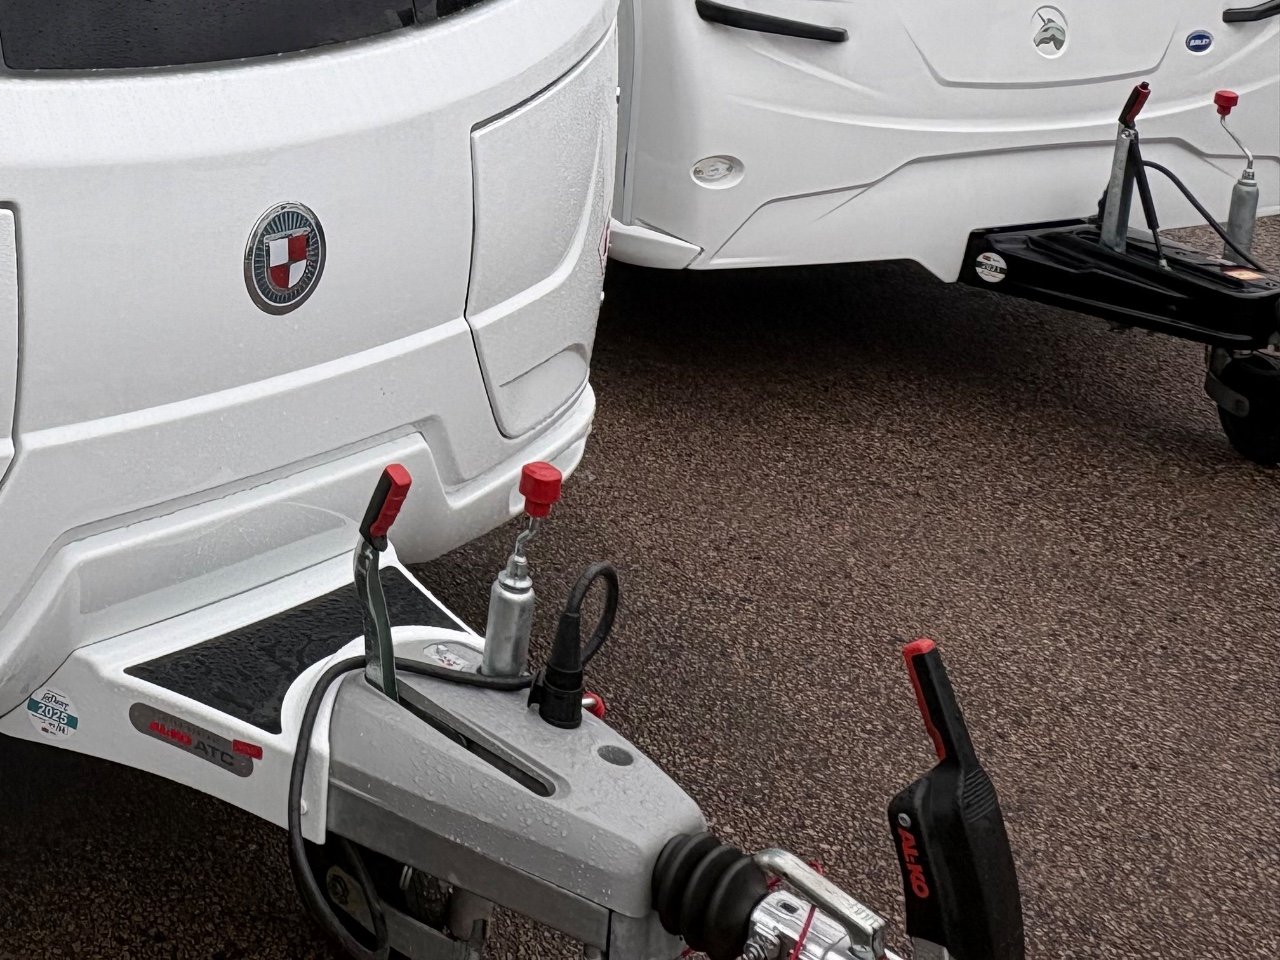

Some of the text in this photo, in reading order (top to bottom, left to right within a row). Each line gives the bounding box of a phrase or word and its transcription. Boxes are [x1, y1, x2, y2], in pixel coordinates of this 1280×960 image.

[37, 703, 68, 724] 2025
[194, 740, 235, 767] ATC
[897, 826, 930, 898] AL-KO
